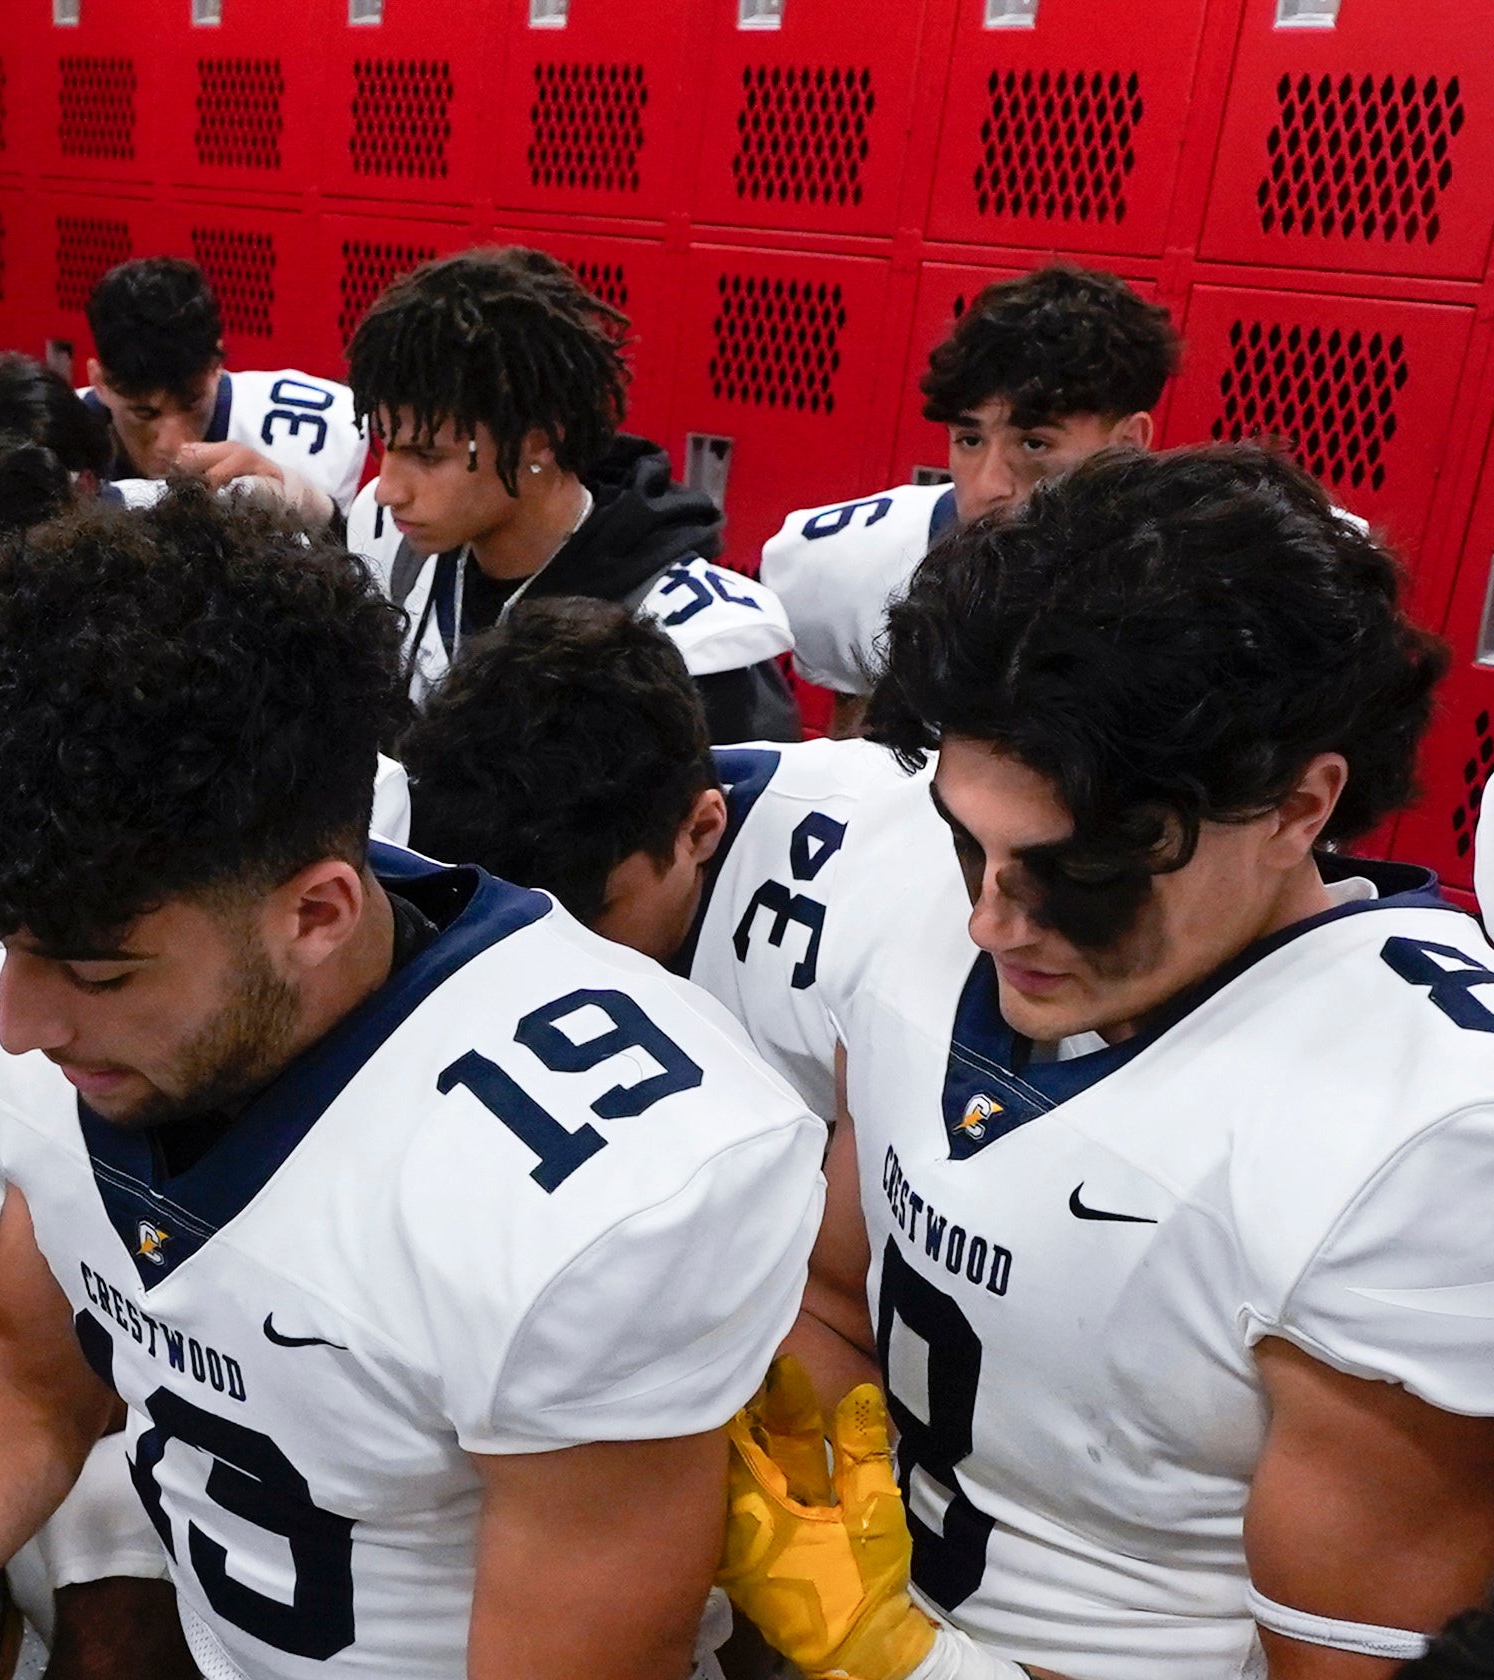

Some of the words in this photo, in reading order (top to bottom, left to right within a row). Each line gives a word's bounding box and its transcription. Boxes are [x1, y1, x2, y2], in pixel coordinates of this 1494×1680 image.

[262, 379, 334, 455] 30
[438, 988, 703, 1194] 19
[882, 1143, 1013, 1297] CRESTWOOD
[80, 1260, 247, 1402] CRESTWOOD
